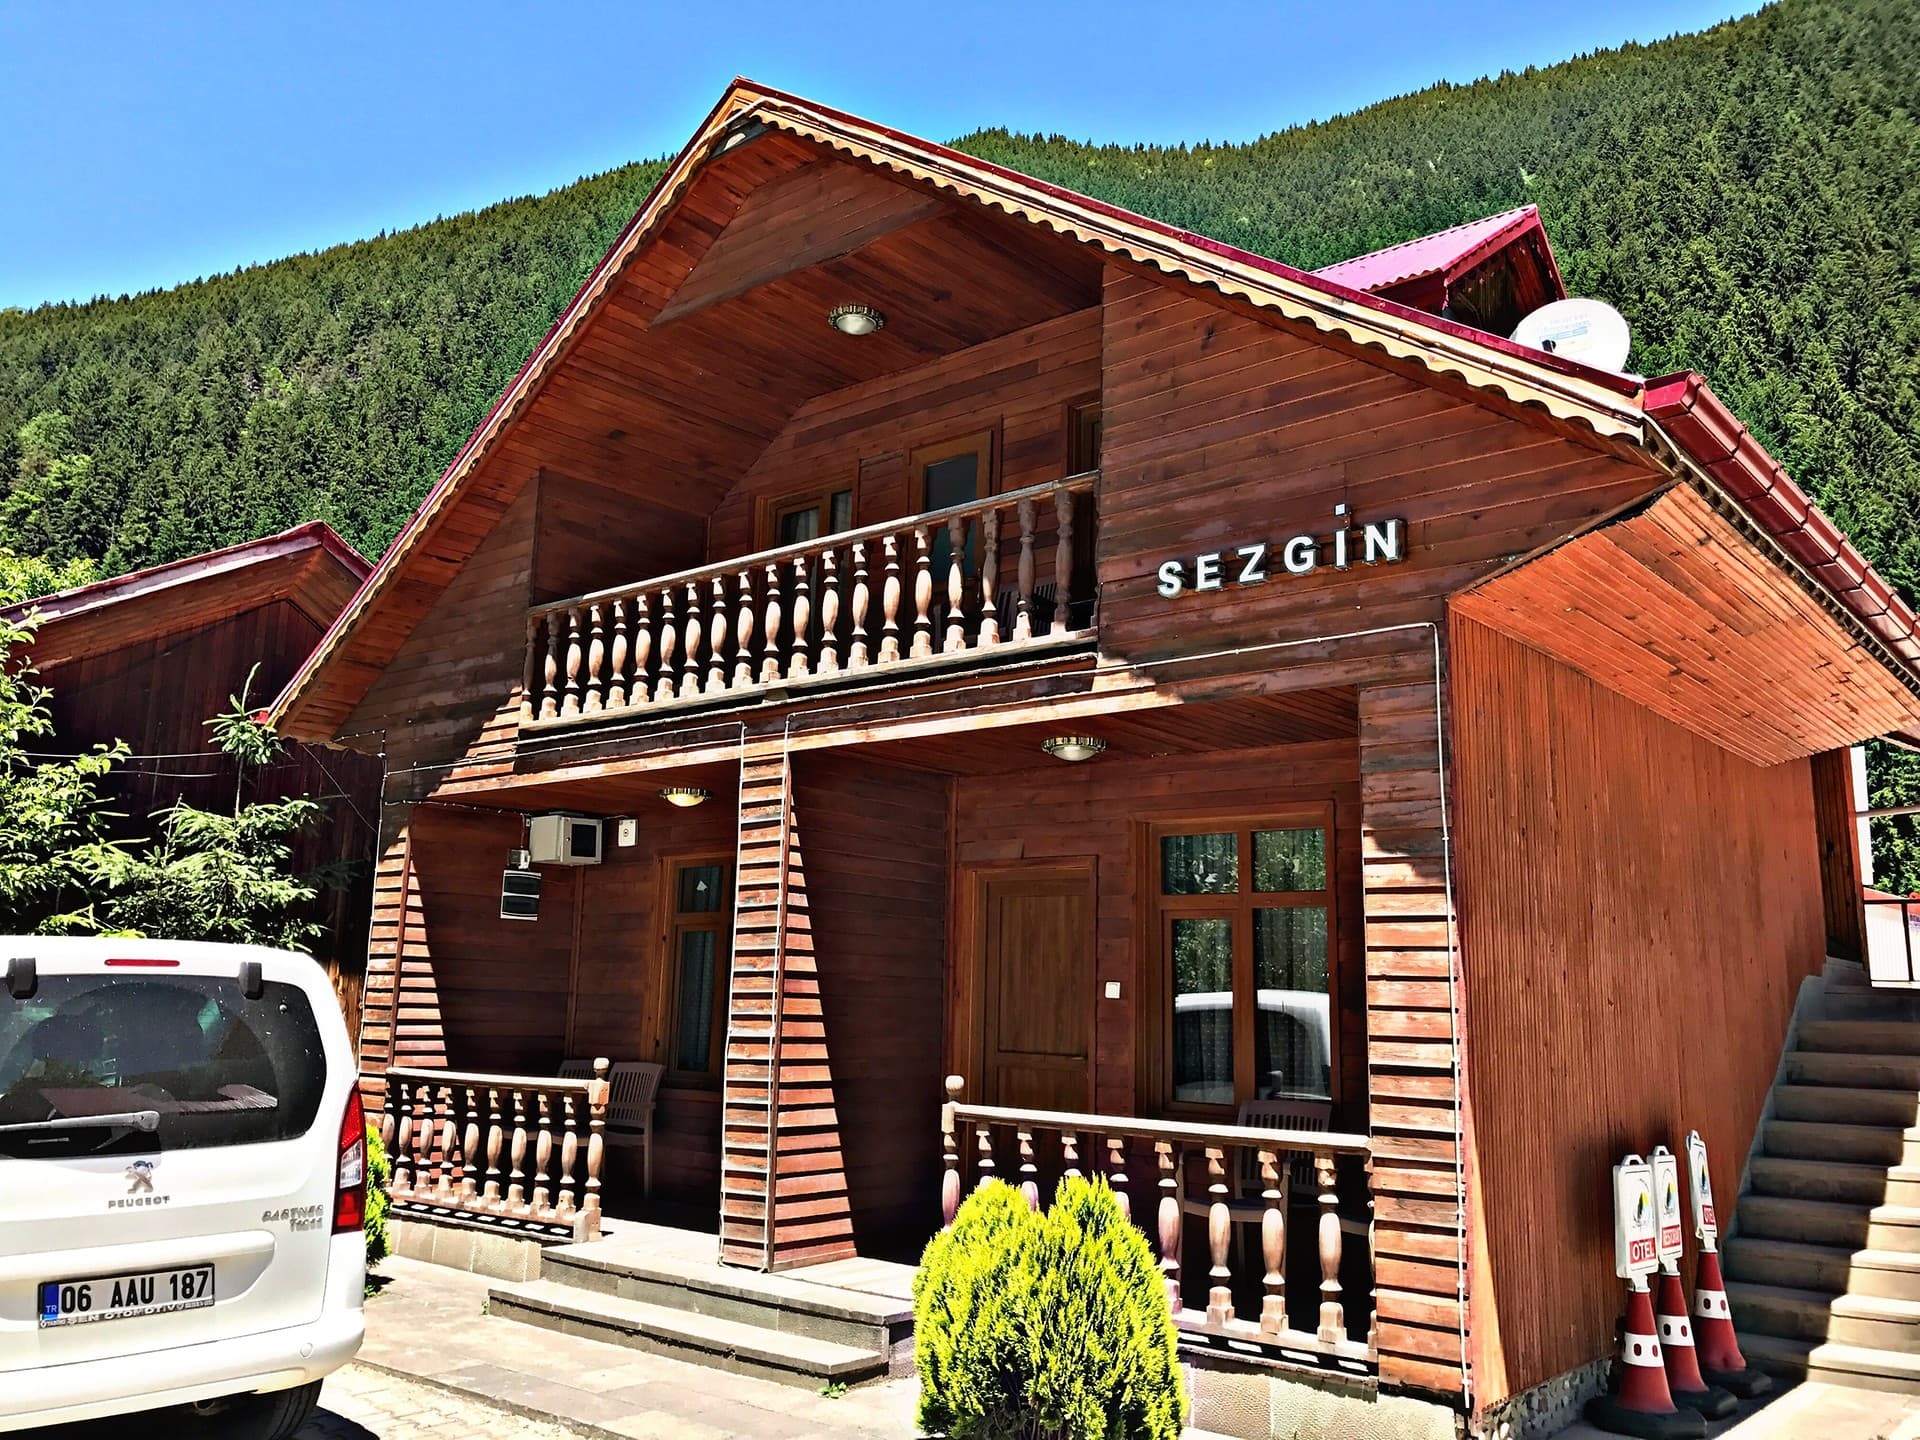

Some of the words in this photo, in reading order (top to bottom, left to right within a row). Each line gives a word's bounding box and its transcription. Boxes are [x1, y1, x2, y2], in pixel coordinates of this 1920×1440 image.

[1157, 503, 1403, 599] SEZGİN
[108, 1195, 170, 1208] PEUGEOT
[1632, 1241, 1655, 1260] OTEL
[61, 1284, 92, 1313] 06
[110, 1277, 154, 1308] AAU
[169, 1270, 209, 1300] 187
[46, 1304, 58, 1313] TR
